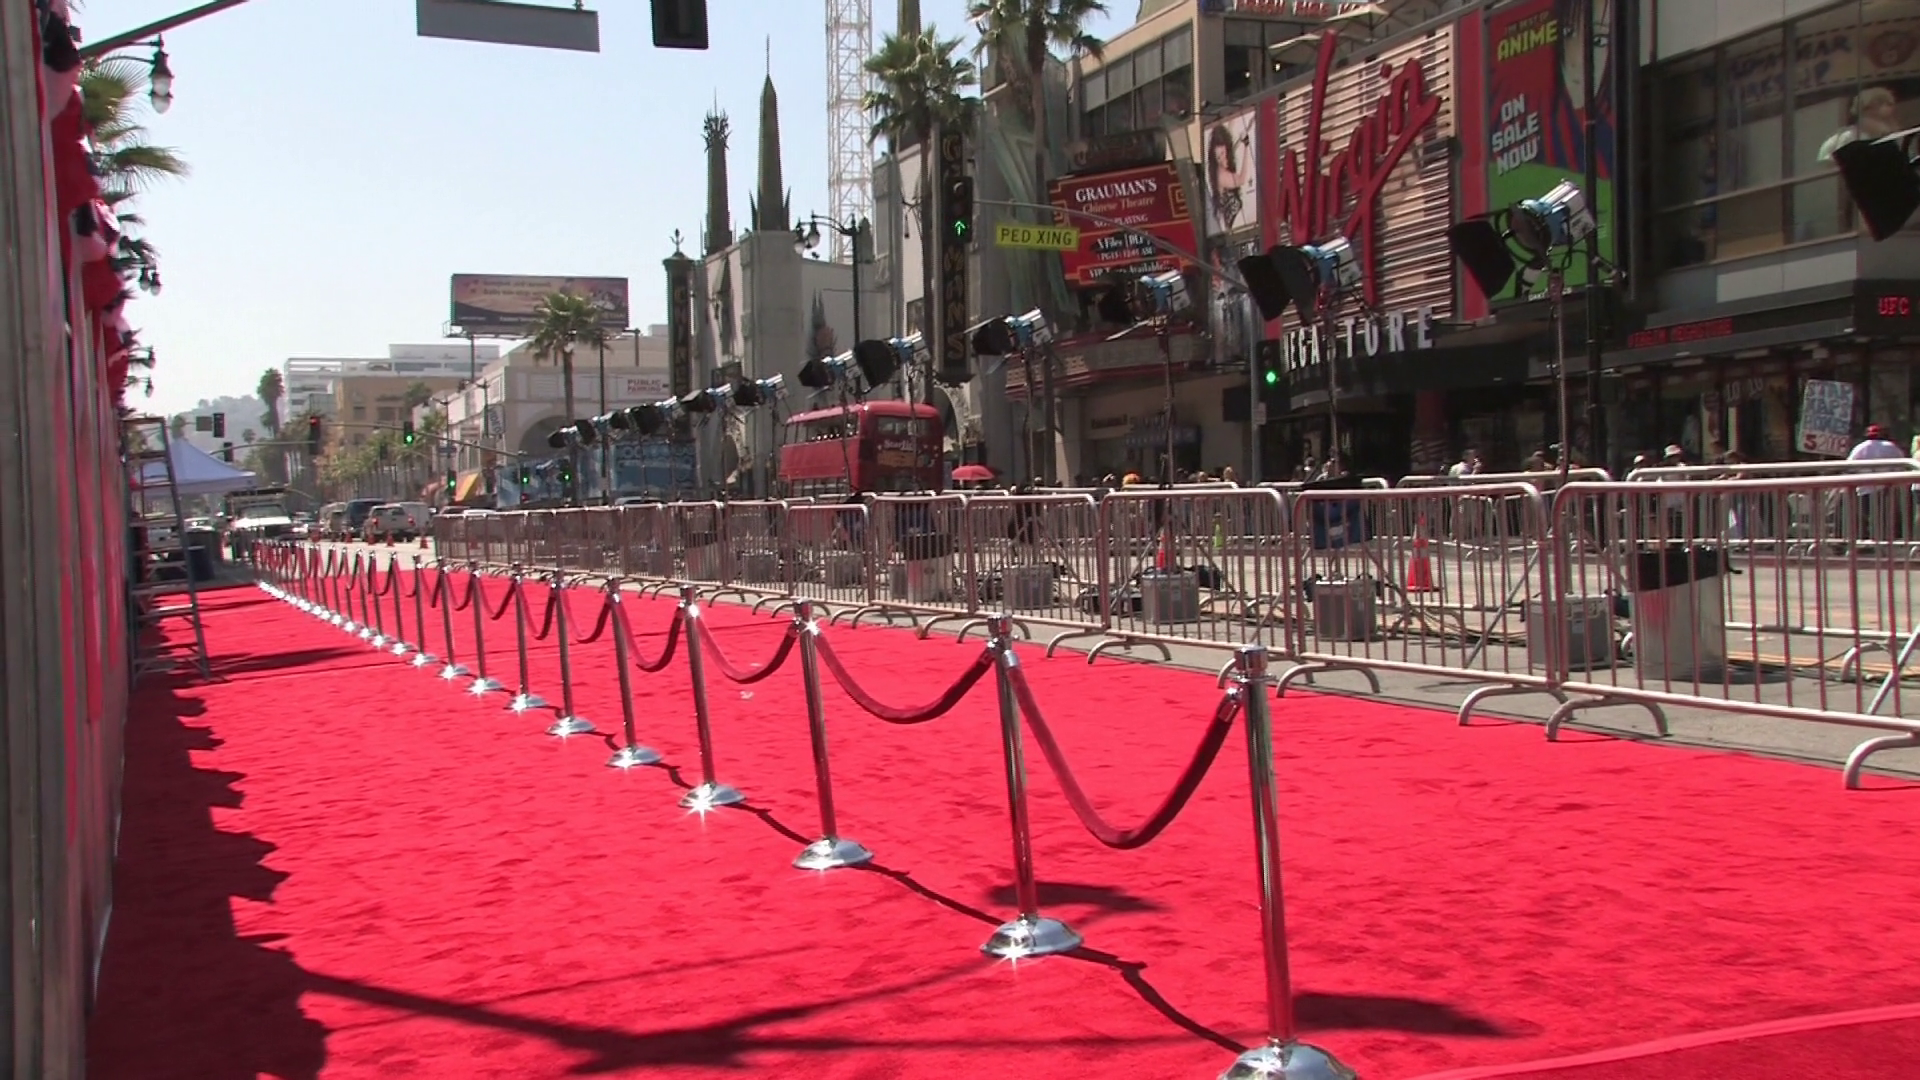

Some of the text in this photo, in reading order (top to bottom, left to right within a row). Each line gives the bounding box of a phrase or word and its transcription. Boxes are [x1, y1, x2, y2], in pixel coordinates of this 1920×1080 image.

[1498, 19, 1559, 61] ANIME
[1501, 93, 1526, 124] ON
[1491, 111, 1539, 152] SALE
[1279, 28, 1441, 306] Virgin
[1496, 136, 1540, 177] NOW
[1075, 178, 1157, 202] GRAUMAN'S
[1001, 227, 1073, 246] PED XING
[1878, 296, 1909, 316] UFC
[1283, 306, 1434, 374] MEGATORE
